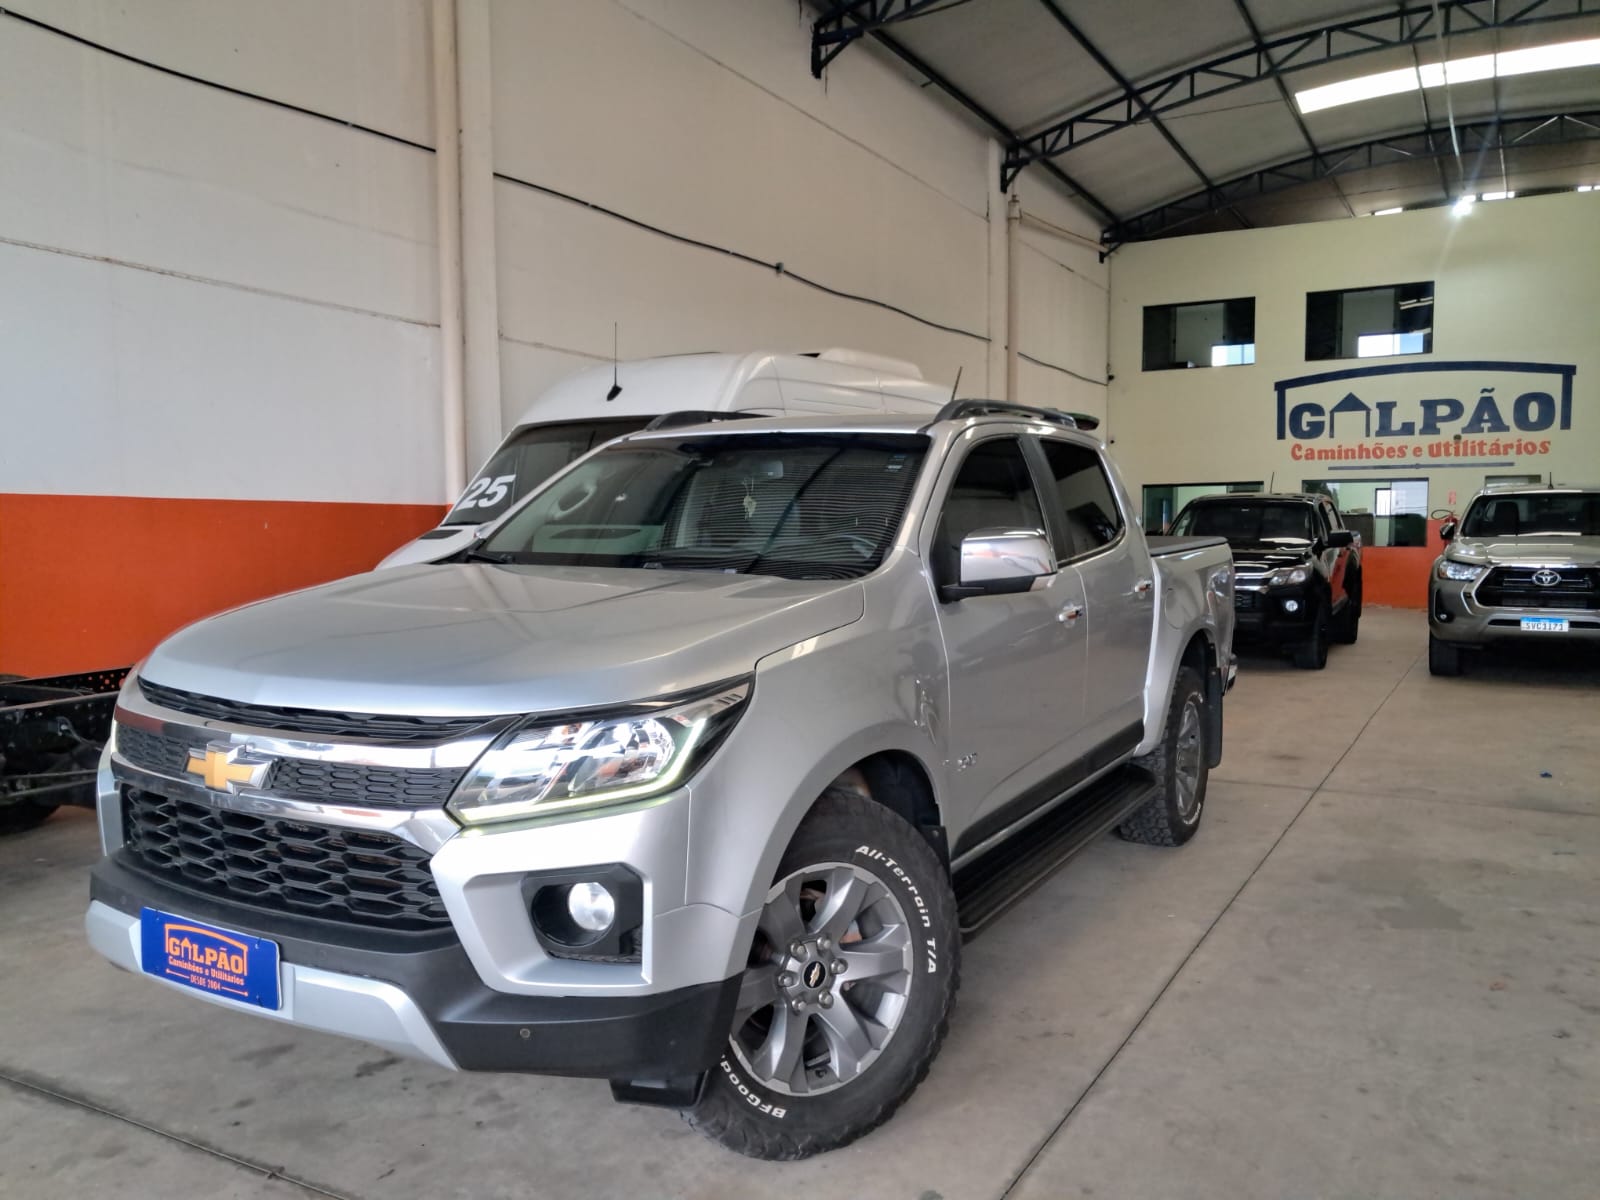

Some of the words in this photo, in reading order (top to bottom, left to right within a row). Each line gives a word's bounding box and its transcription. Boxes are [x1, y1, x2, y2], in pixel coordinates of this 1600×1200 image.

[1289, 387, 1556, 440] GALPÃO
[1291, 442, 1408, 461] Caminhões
[1412, 447, 1423, 458] e
[455, 474, 516, 511] 25
[855, 845, 931, 928] All-Terrain
[926, 937, 937, 973] T/A
[168, 937, 243, 974] GALPÃO
[168, 956, 203, 974] Caminhões
[204, 968, 209, 976] e
